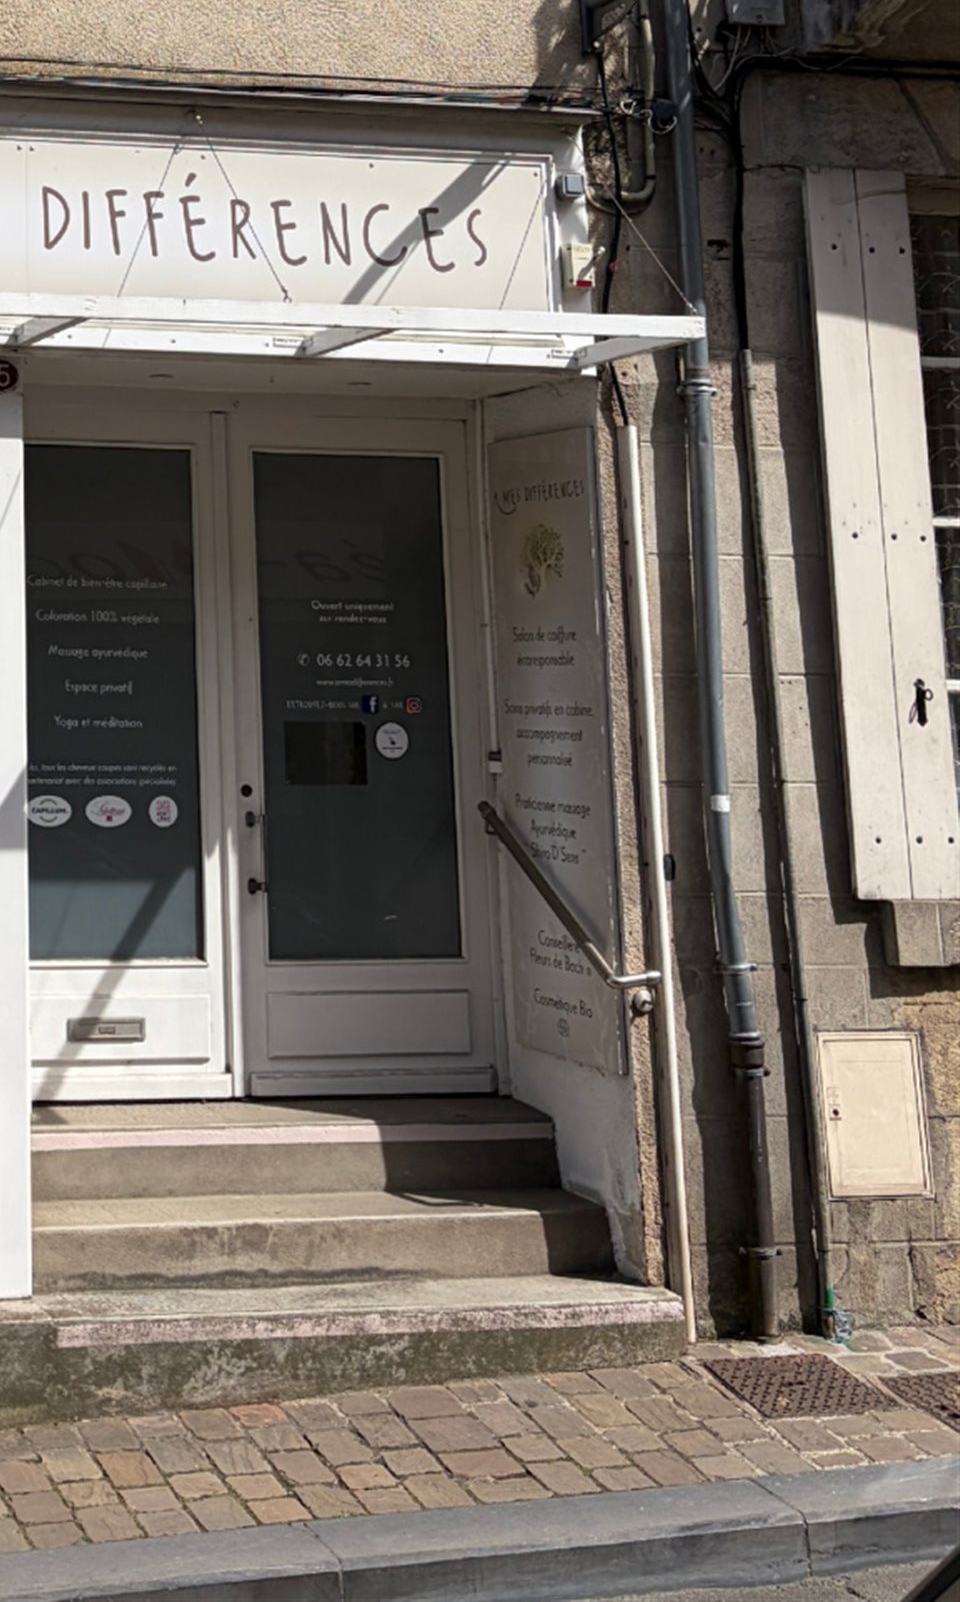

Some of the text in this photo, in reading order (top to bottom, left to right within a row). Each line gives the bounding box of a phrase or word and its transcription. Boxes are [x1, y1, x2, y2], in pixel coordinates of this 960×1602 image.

[41, 172, 488, 272] DIFFÉRENCES
[502, 488, 521, 505] MES
[524, 479, 585, 503] DIFFÉRENCES
[66, 574, 79, 587] de
[311, 600, 343, 611] Ouvert
[35, 608, 87, 622] Coloration
[90, 610, 118, 623] 100%
[47, 644, 90, 660] Massage
[316, 653, 411, 668] 06 62 64 31 56
[64, 678, 98, 695] Espace
[53, 714, 79, 730] Yoga
[81, 717, 91, 728] et
